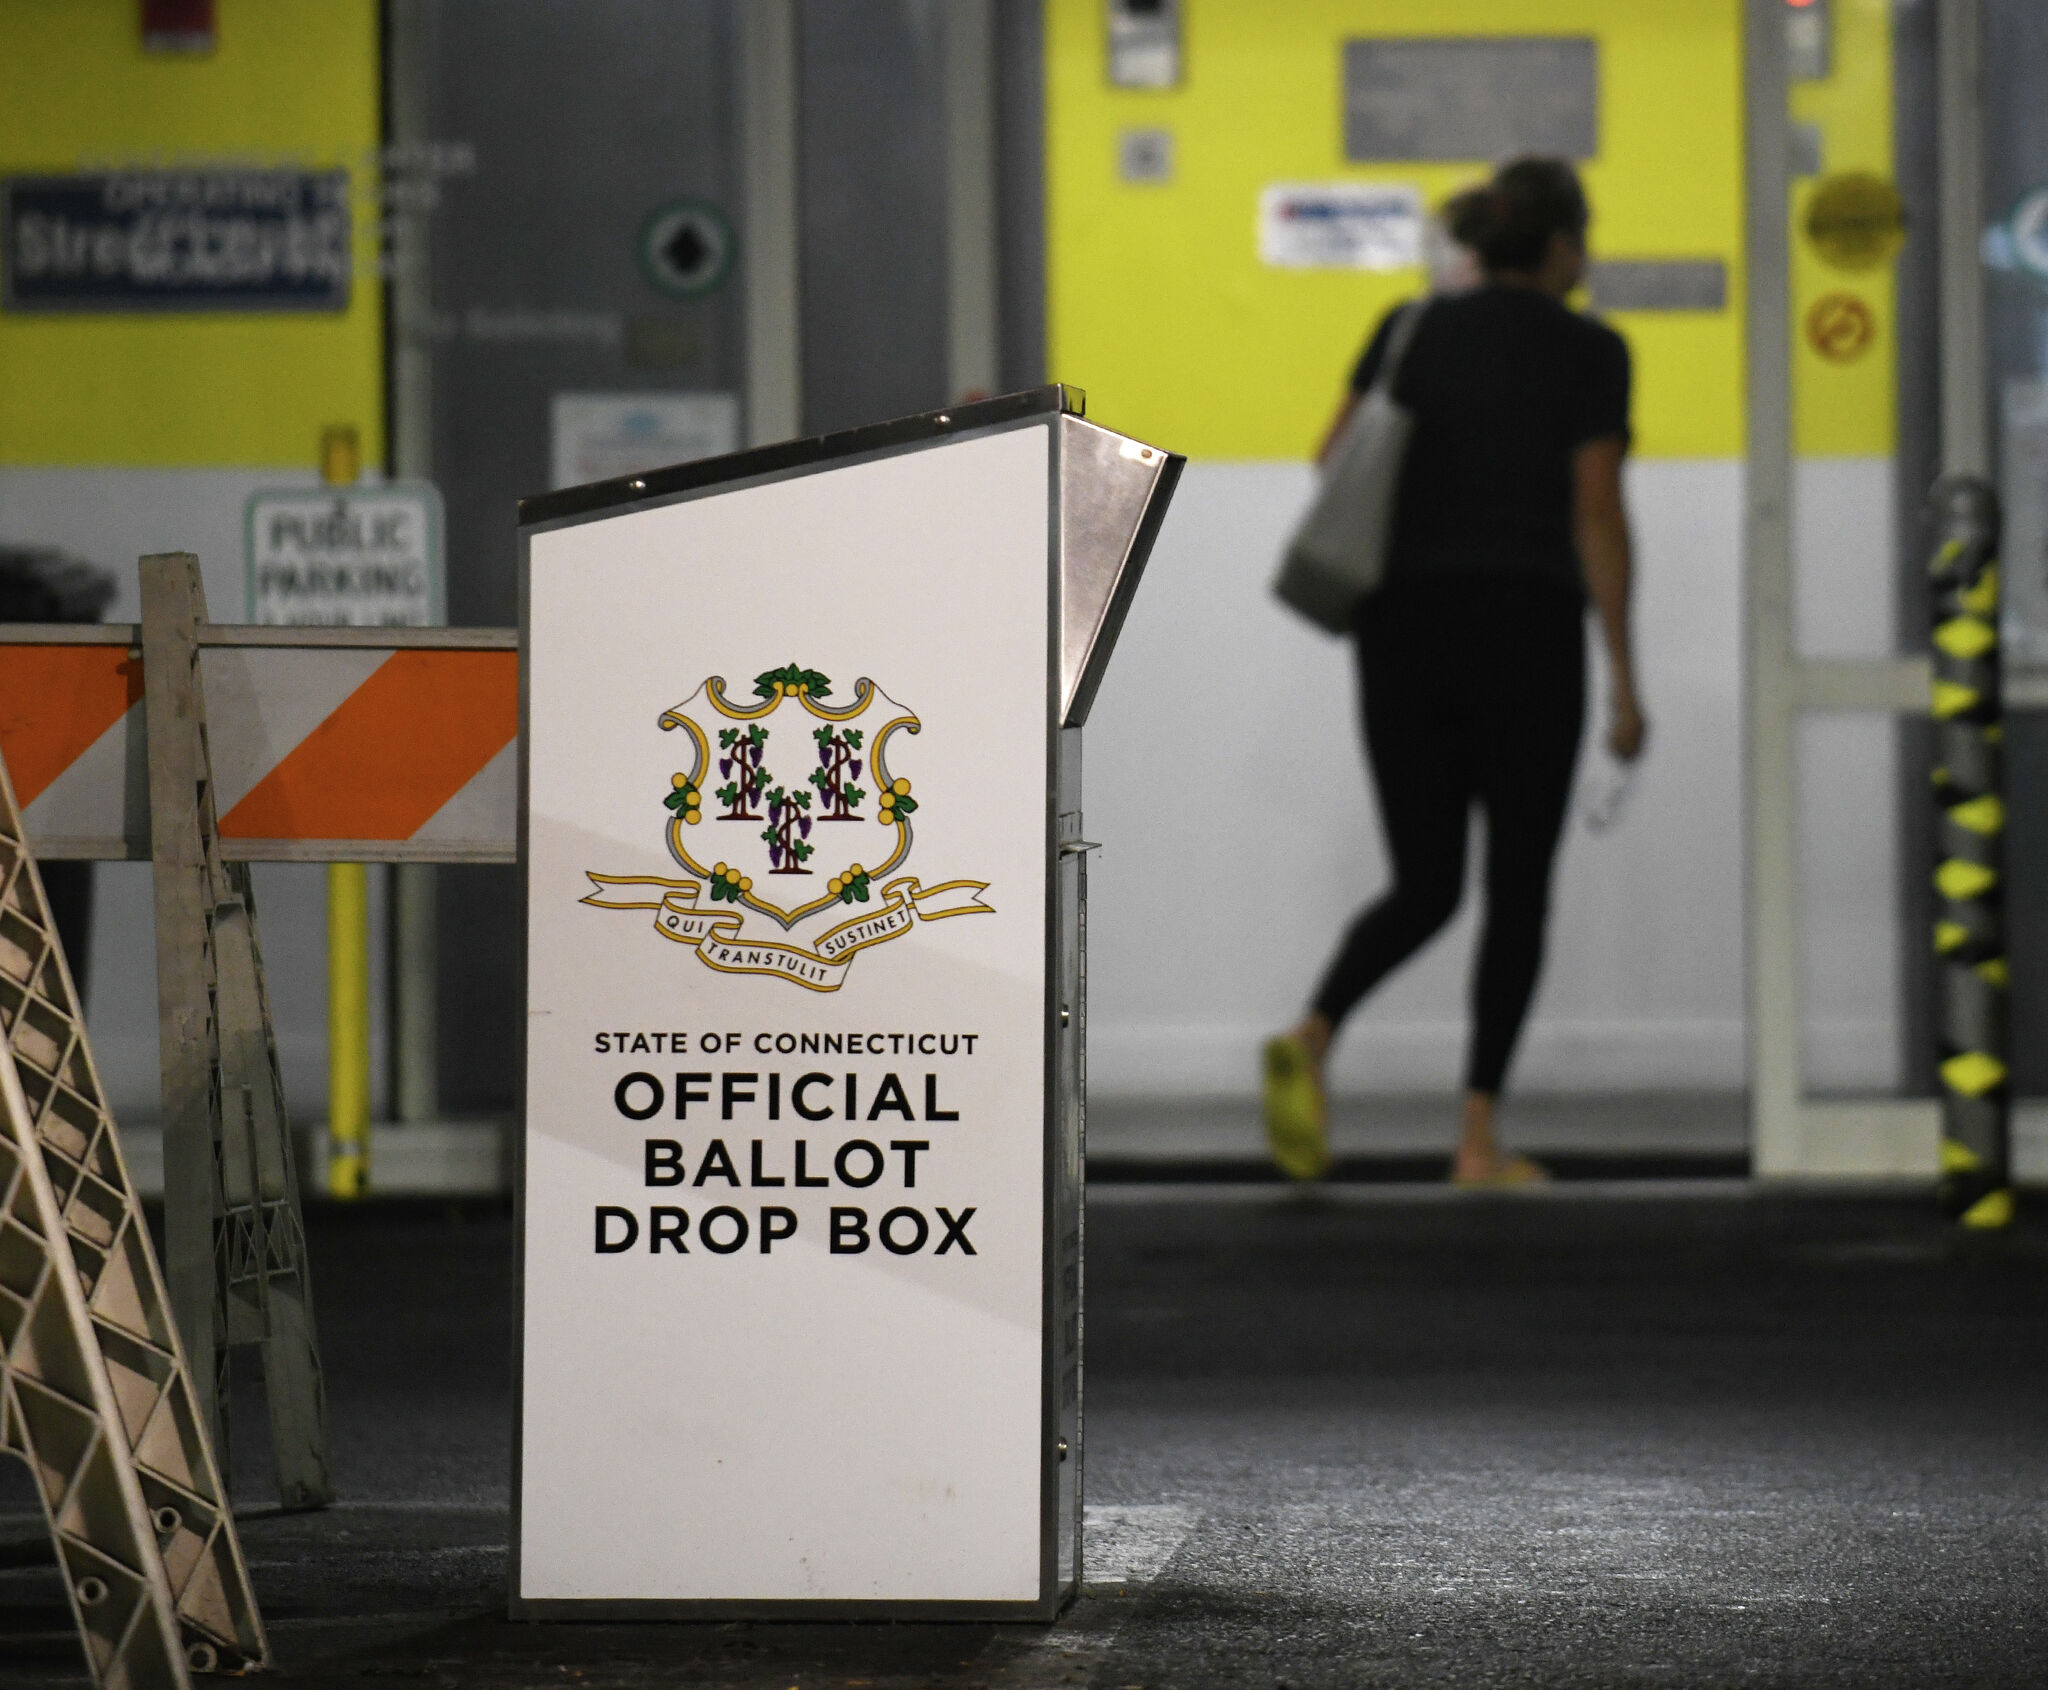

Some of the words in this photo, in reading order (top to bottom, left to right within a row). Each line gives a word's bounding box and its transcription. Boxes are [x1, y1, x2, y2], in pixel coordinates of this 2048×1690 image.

[269, 512, 411, 549] PUBLIC
[258, 560, 428, 597] PARKING
[666, 915, 704, 934] QUI
[707, 943, 828, 982] TRANSTULIT
[825, 910, 906, 955] SUSTINET
[595, 1032, 688, 1054] STATE
[700, 1032, 742, 1054] OF
[753, 1032, 979, 1055] CONNECTICUT
[614, 1071, 960, 1122] OFFICIAL
[644, 1138, 930, 1189] BALLOT
[594, 1205, 798, 1255] DROP
[829, 1206, 978, 1256] BOX
